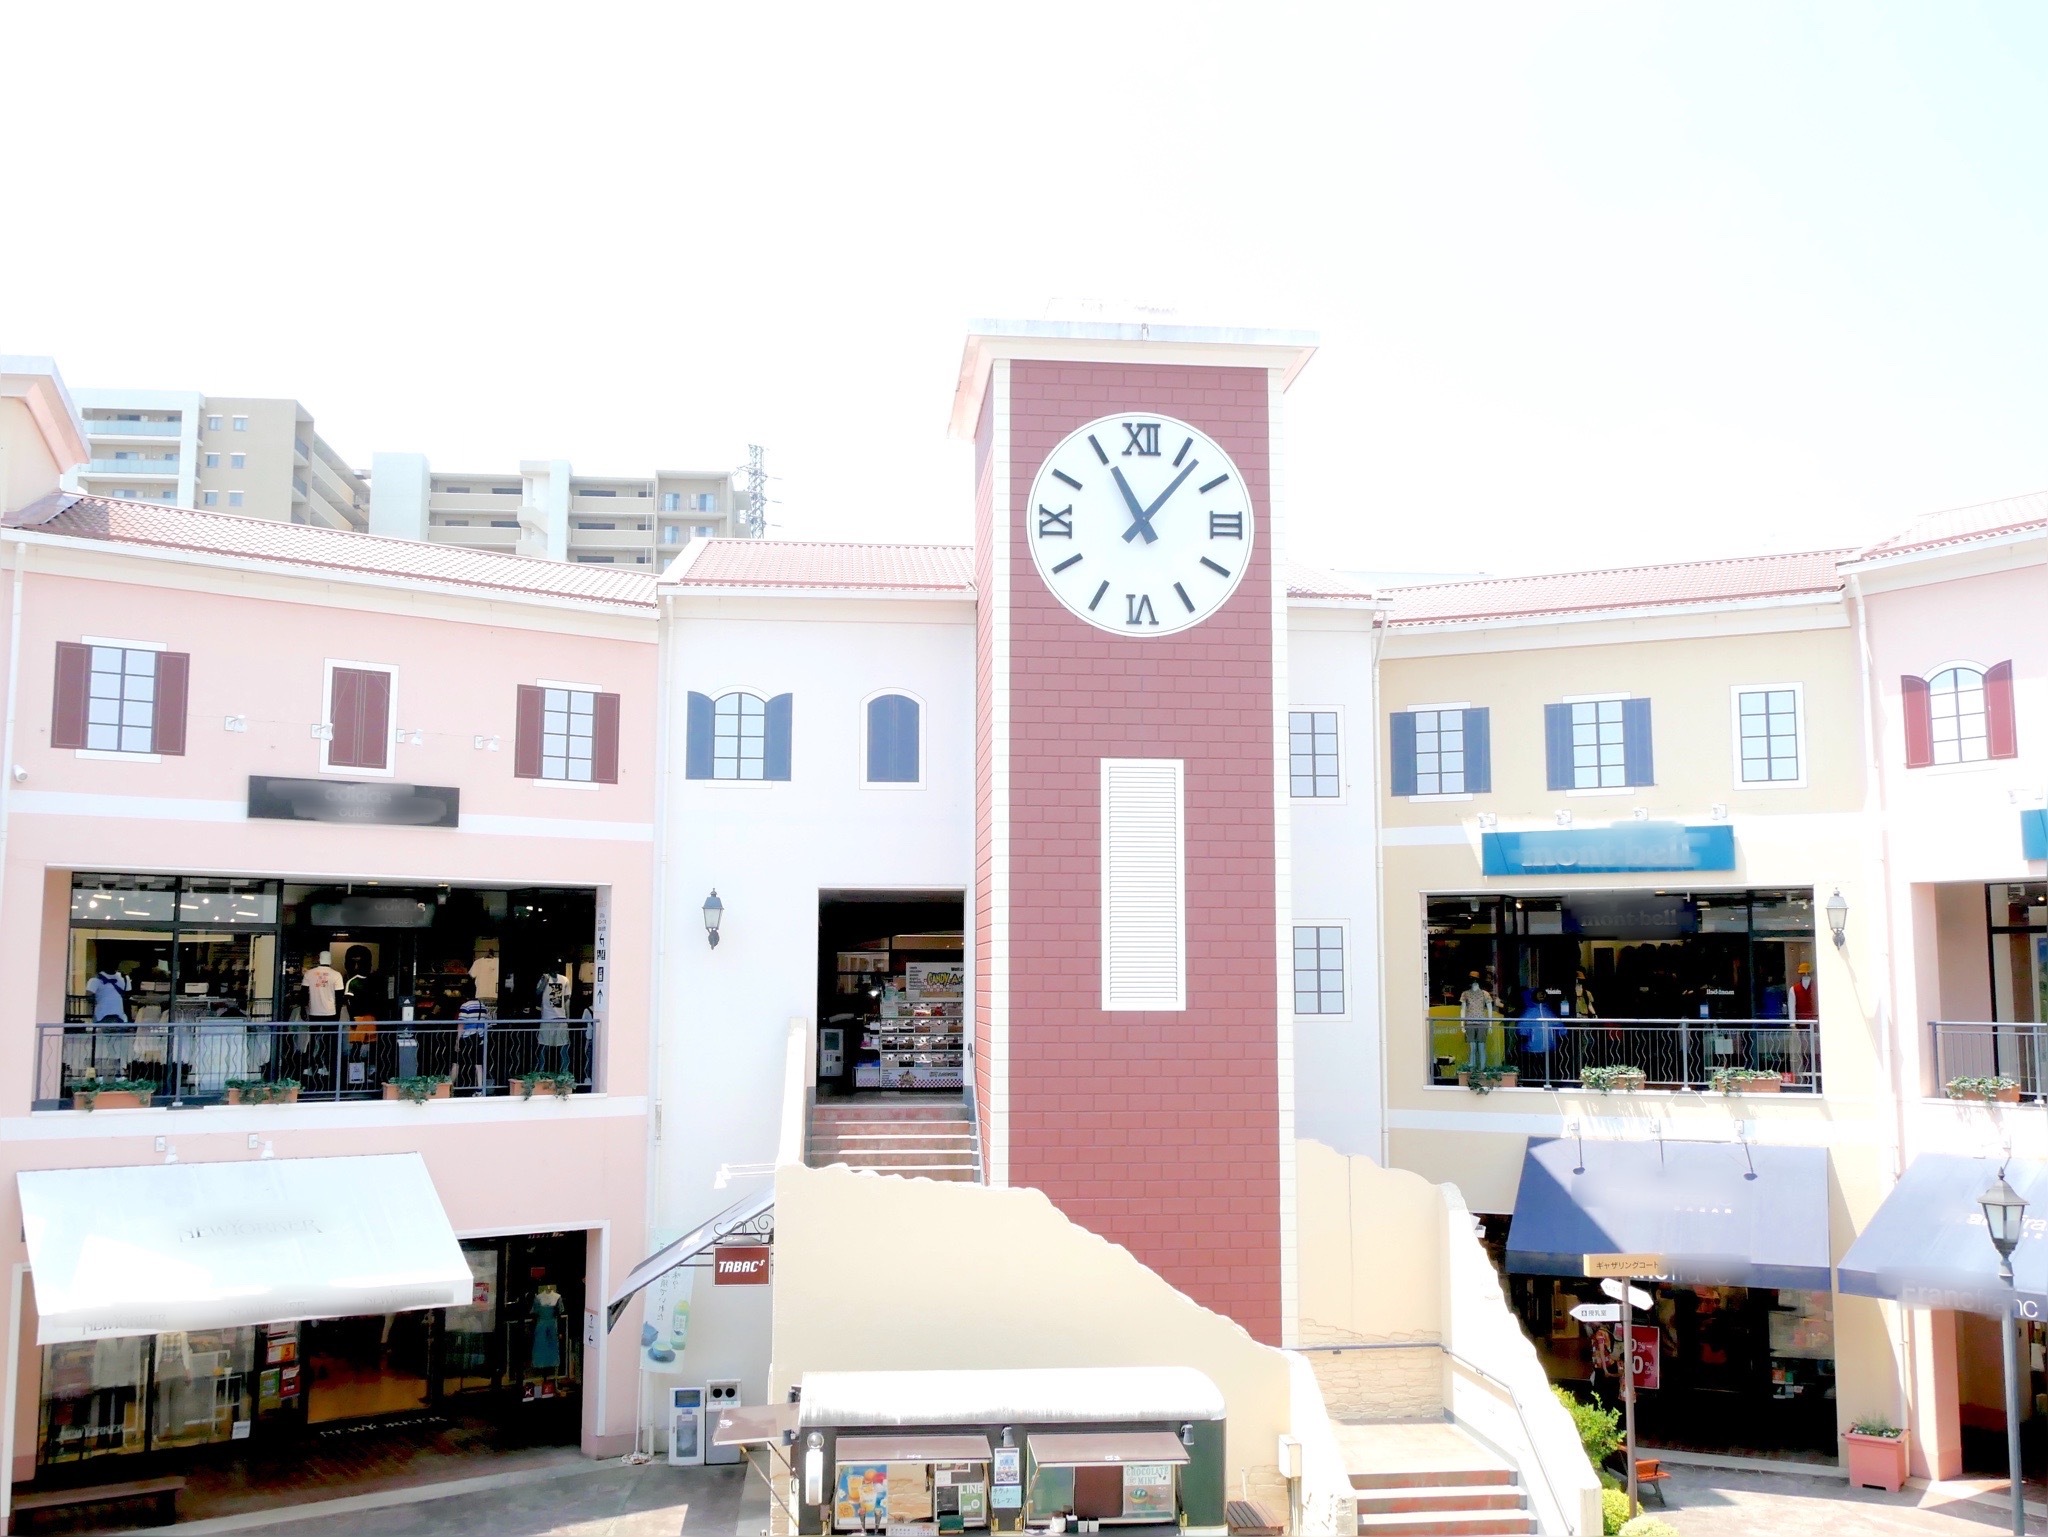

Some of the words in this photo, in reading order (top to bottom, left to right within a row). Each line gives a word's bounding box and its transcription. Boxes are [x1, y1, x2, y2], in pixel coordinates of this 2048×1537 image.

[1122, 423, 1161, 456] XII
[1596, 1260, 1659, 1270] ギャザリングコート
[1126, 1466, 1169, 1476] CHOCOLATE
[960, 1484, 983, 1494] LINE
